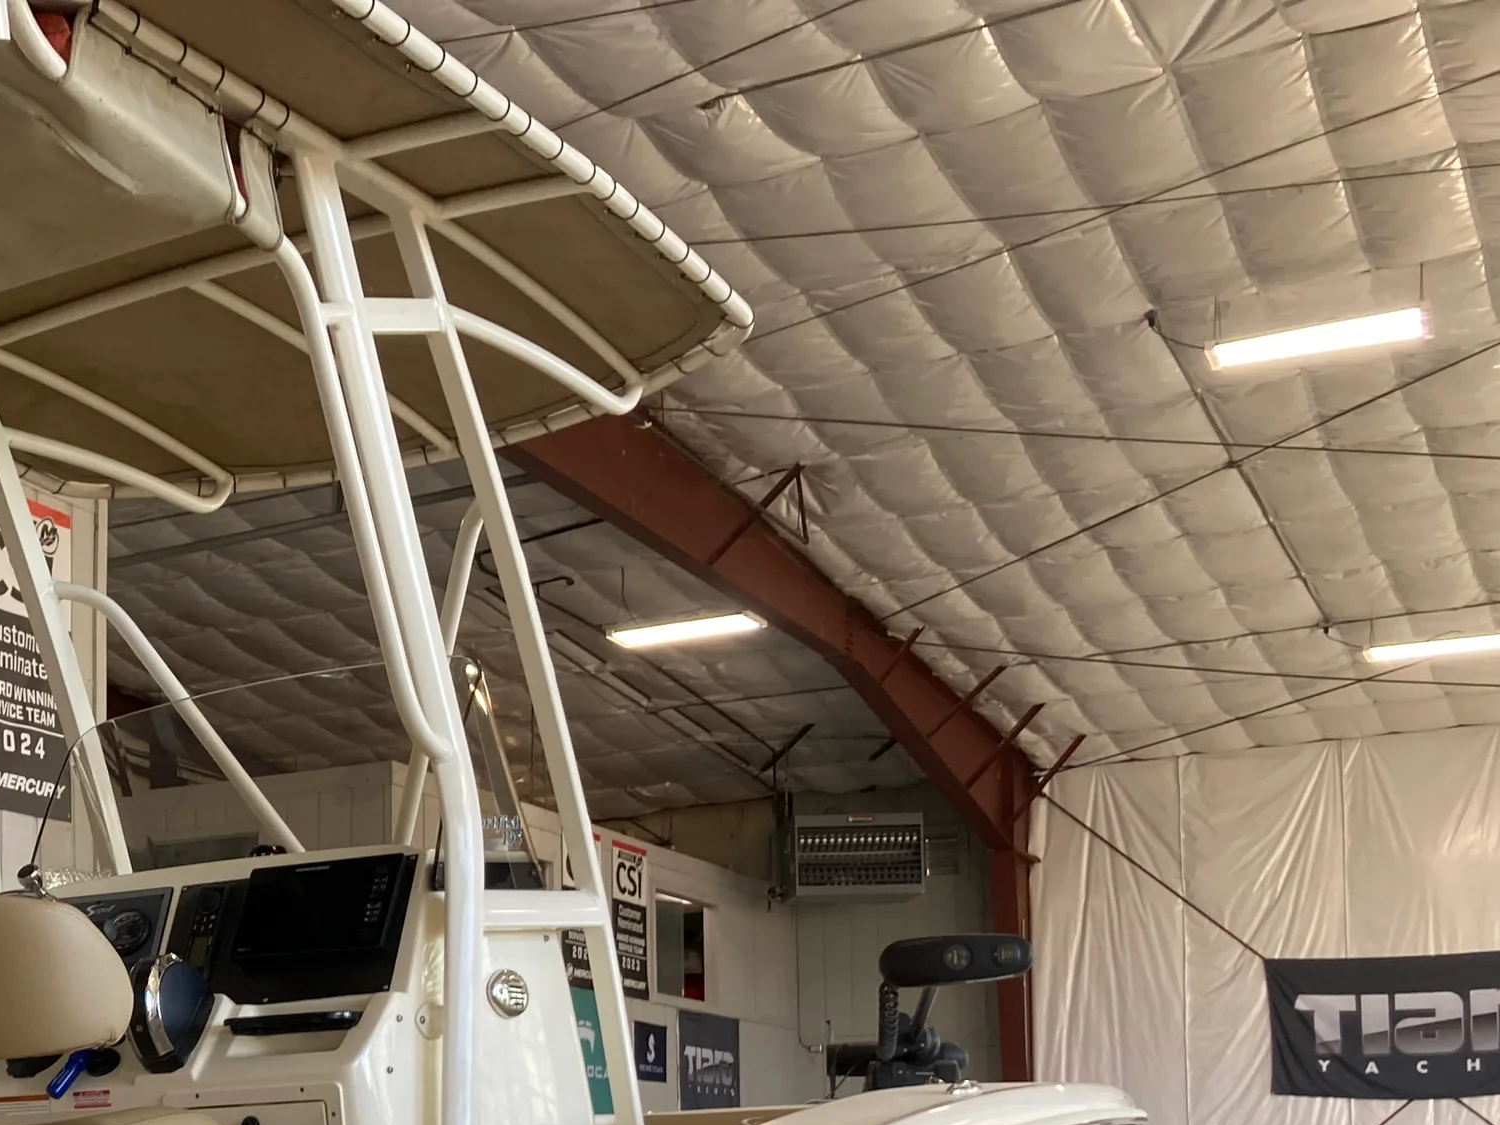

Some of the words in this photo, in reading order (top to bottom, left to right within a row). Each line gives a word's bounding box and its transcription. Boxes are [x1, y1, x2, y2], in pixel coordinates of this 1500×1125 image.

[13, 684, 57, 711] WINNIN
[26, 706, 56, 728] TEAM
[616, 861, 642, 899] CSI
[572, 945, 588, 960] 202
[1318, 1057, 1482, 1075] YACH
